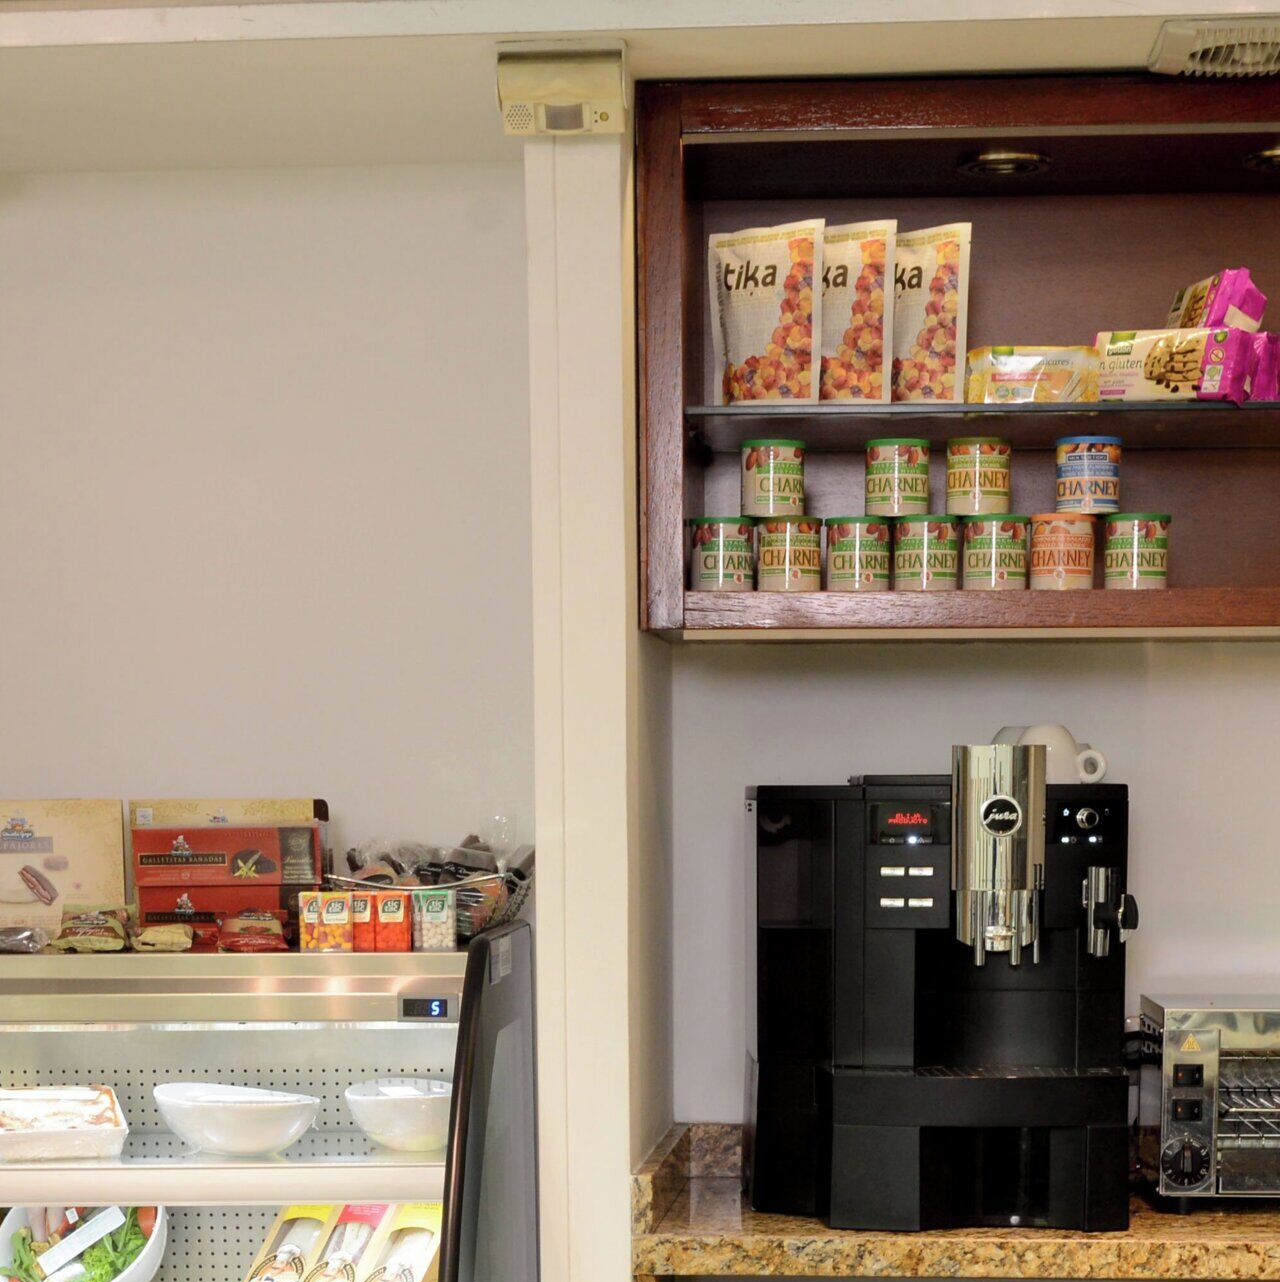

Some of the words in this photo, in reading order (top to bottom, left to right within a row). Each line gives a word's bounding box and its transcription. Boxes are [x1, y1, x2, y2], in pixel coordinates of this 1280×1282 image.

[723, 260, 778, 291] tika
[1107, 358, 1143, 371] gluten
[948, 469, 1009, 489] CHARNEY
[1057, 480, 1119, 497] CHARNEY
[1032, 549, 1092, 567] CHARNEY
[1106, 552, 1167, 568] CHANEY
[983, 808, 1018, 825] jura
